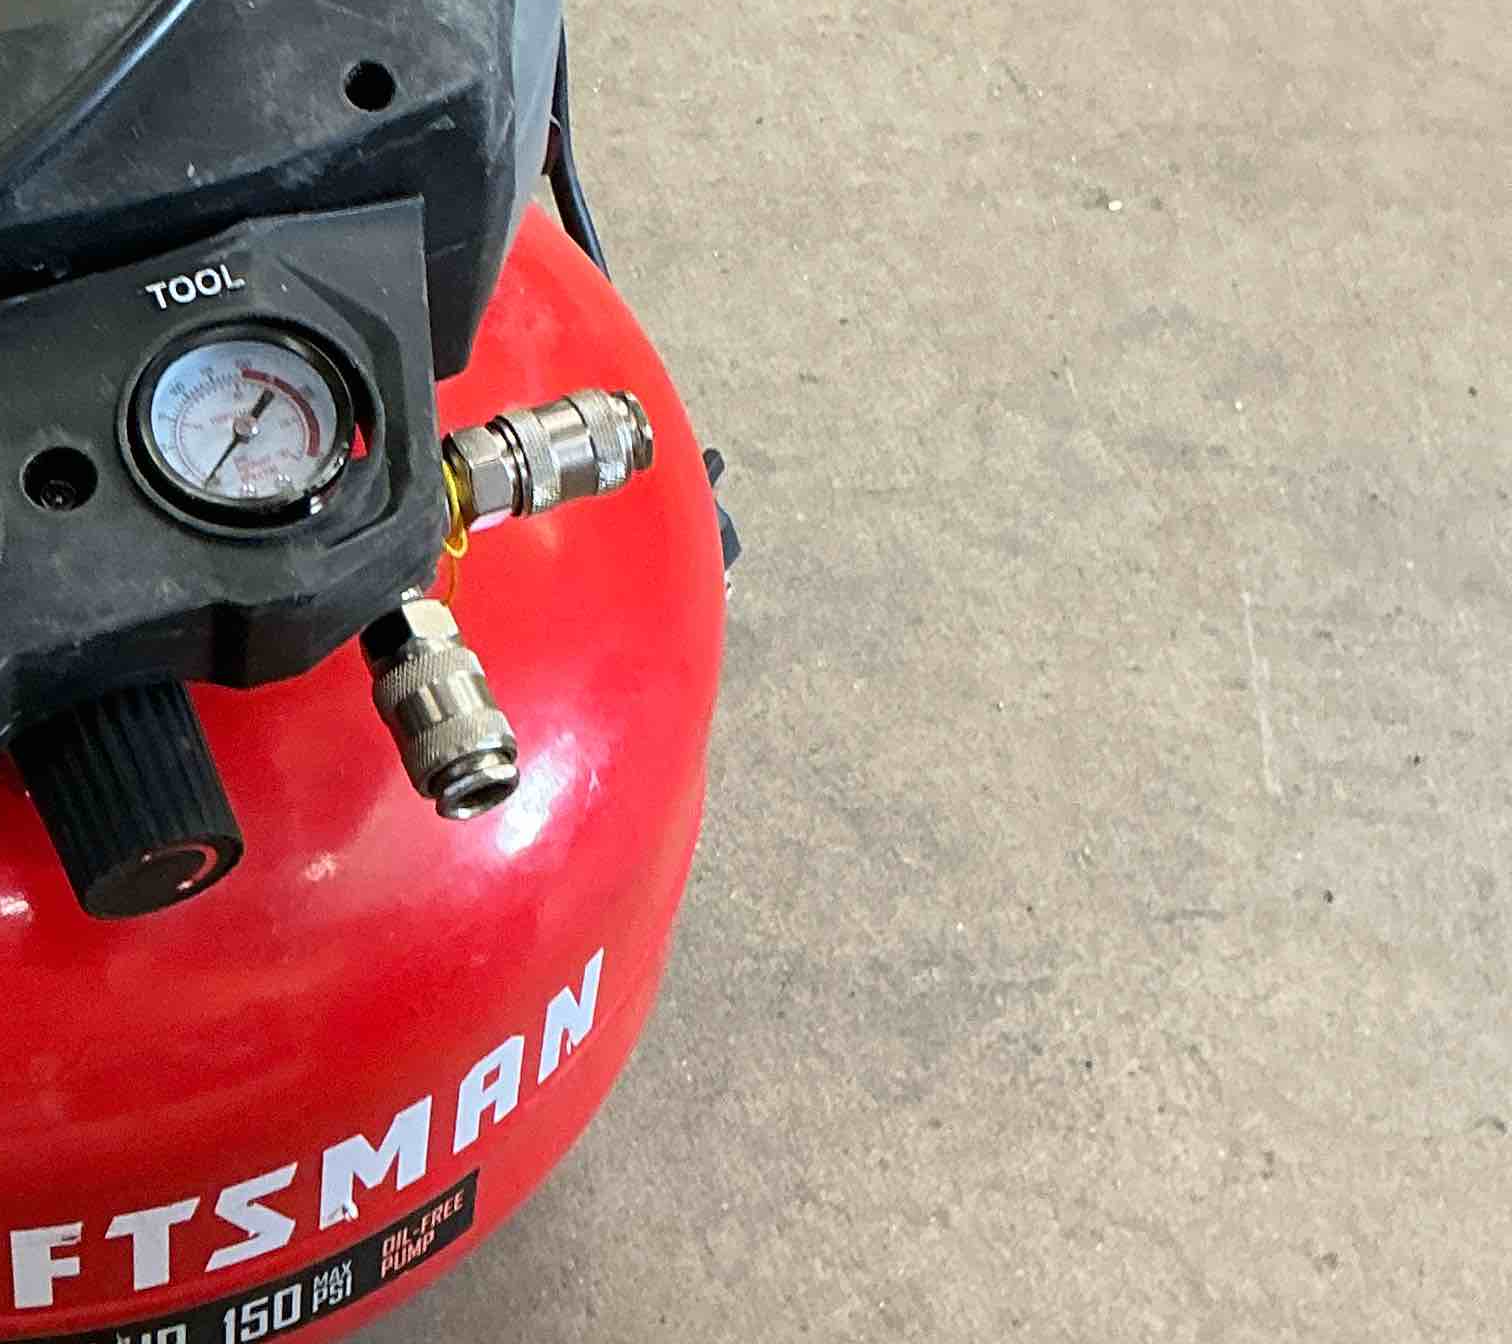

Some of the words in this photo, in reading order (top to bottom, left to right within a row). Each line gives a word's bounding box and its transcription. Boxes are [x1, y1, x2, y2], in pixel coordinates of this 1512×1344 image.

[144, 262, 246, 311] TOOL
[382, 1189, 466, 1258] OIL-FREE
[313, 1258, 353, 1294] MAX
[381, 1229, 436, 1280] PUMP
[312, 1276, 353, 1314] PSI
